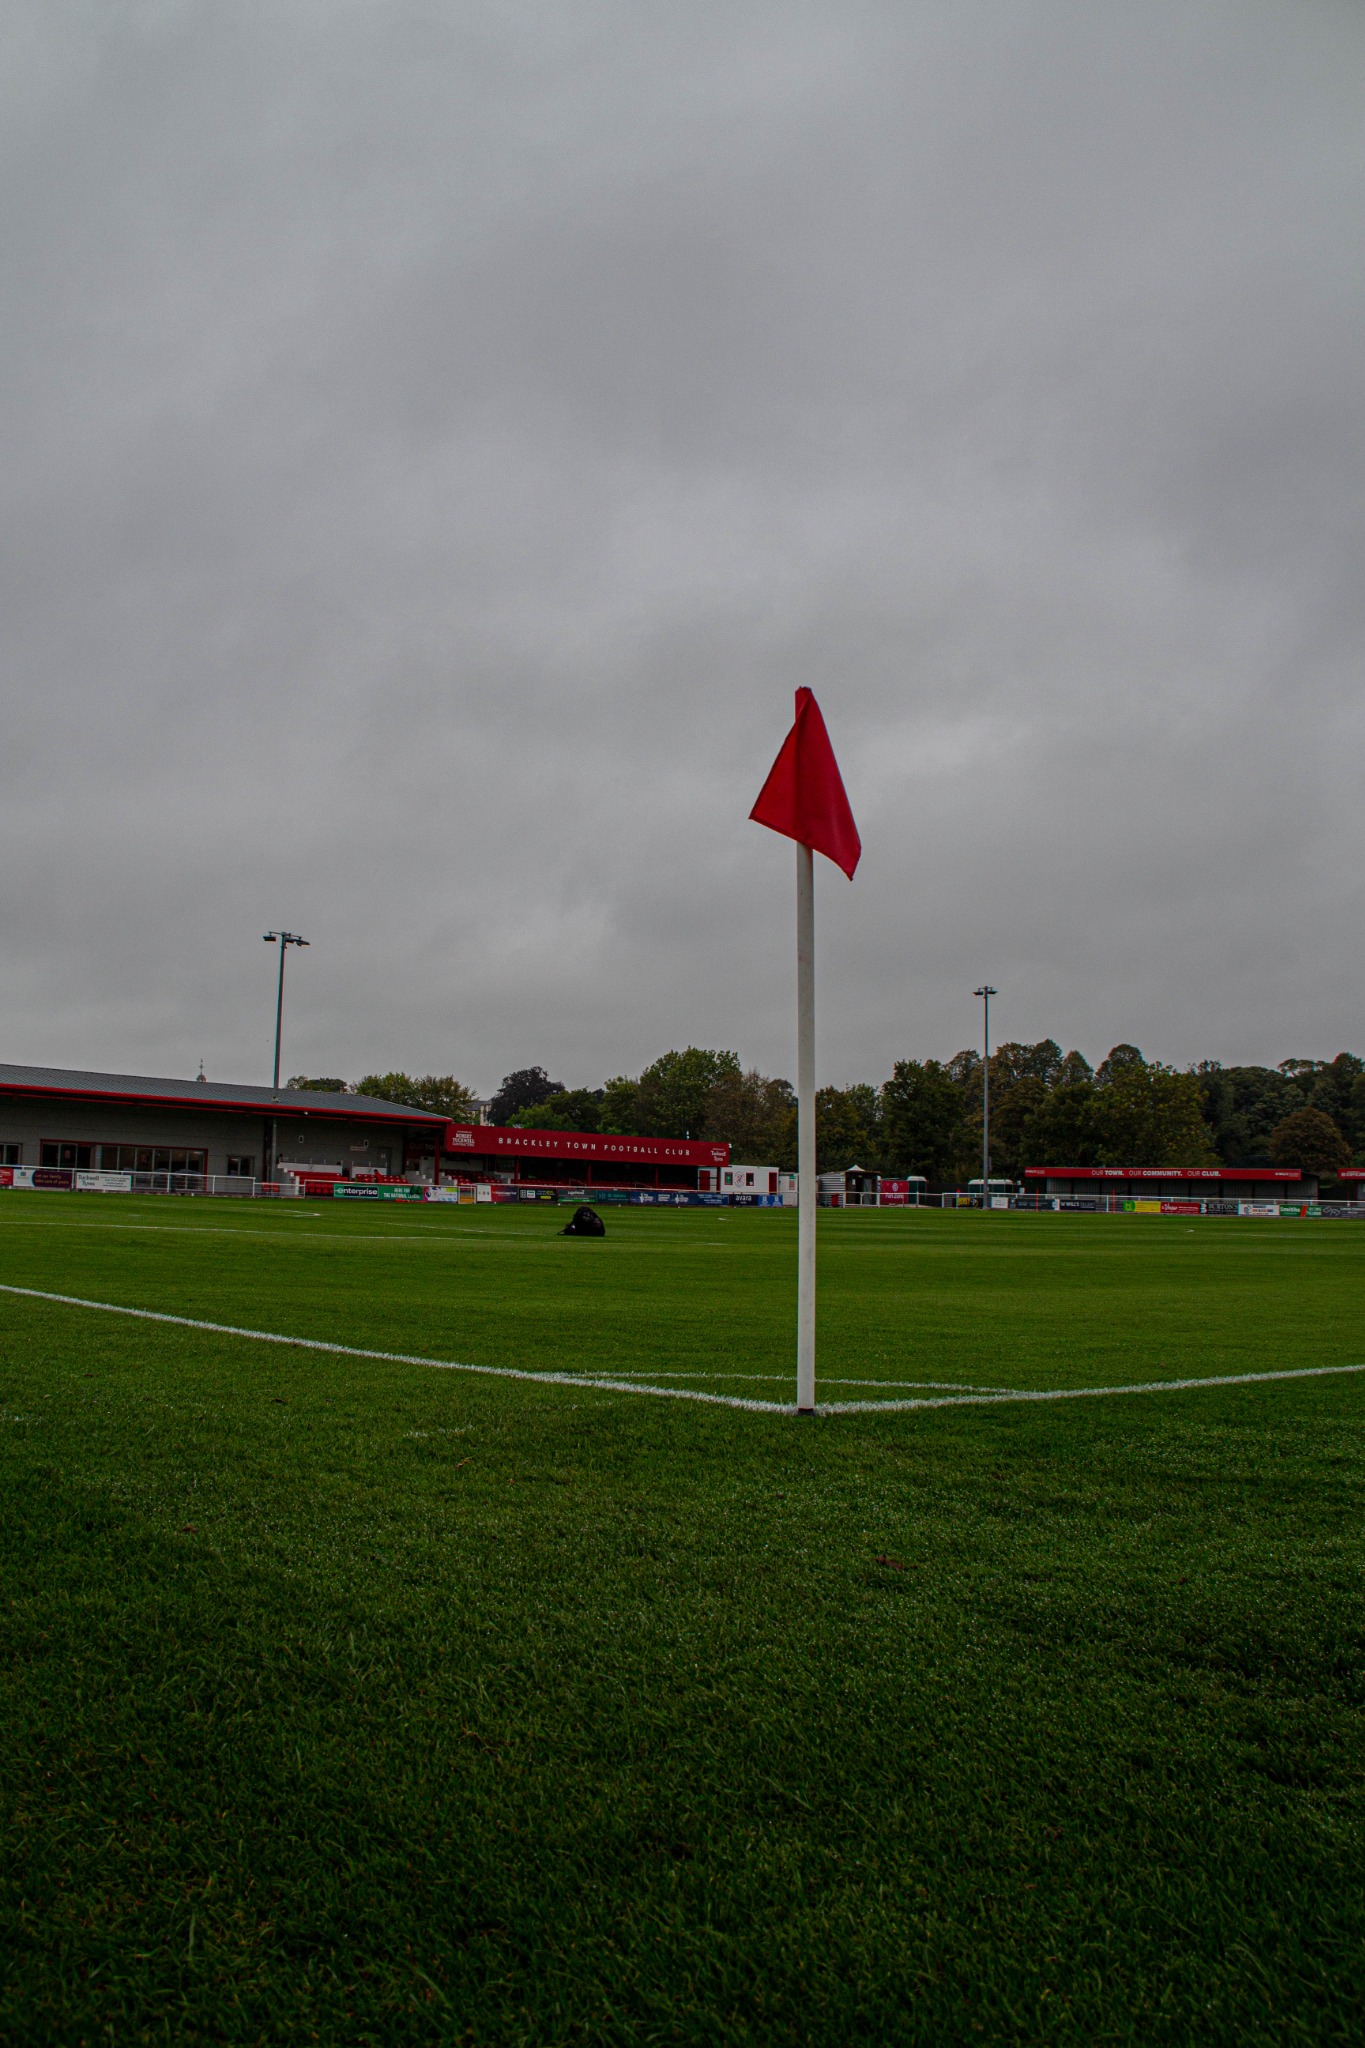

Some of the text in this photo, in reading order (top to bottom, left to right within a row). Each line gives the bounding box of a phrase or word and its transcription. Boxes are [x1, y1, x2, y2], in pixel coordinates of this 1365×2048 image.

[498, 1137, 690, 1156] BRACKLEY TOWN FOOTBALL CLUB
[336, 1187, 378, 1196] enterprise
